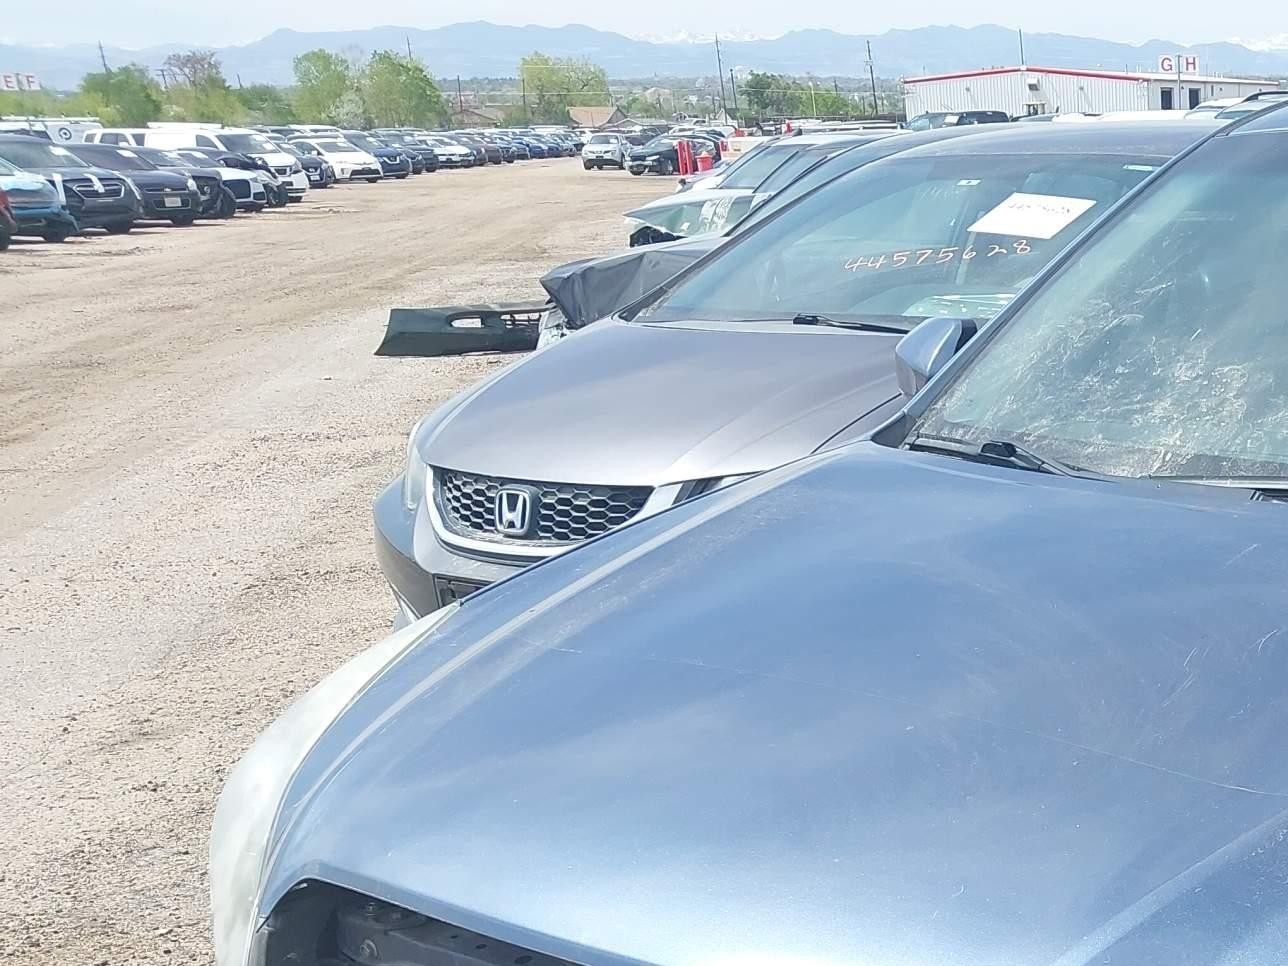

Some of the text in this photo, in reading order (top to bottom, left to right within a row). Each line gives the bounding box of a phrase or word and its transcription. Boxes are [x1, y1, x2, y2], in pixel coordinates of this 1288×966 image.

[1160, 56, 1196, 72] G H
[3, 75, 35, 89] E F
[844, 238, 1032, 273] 44575628
